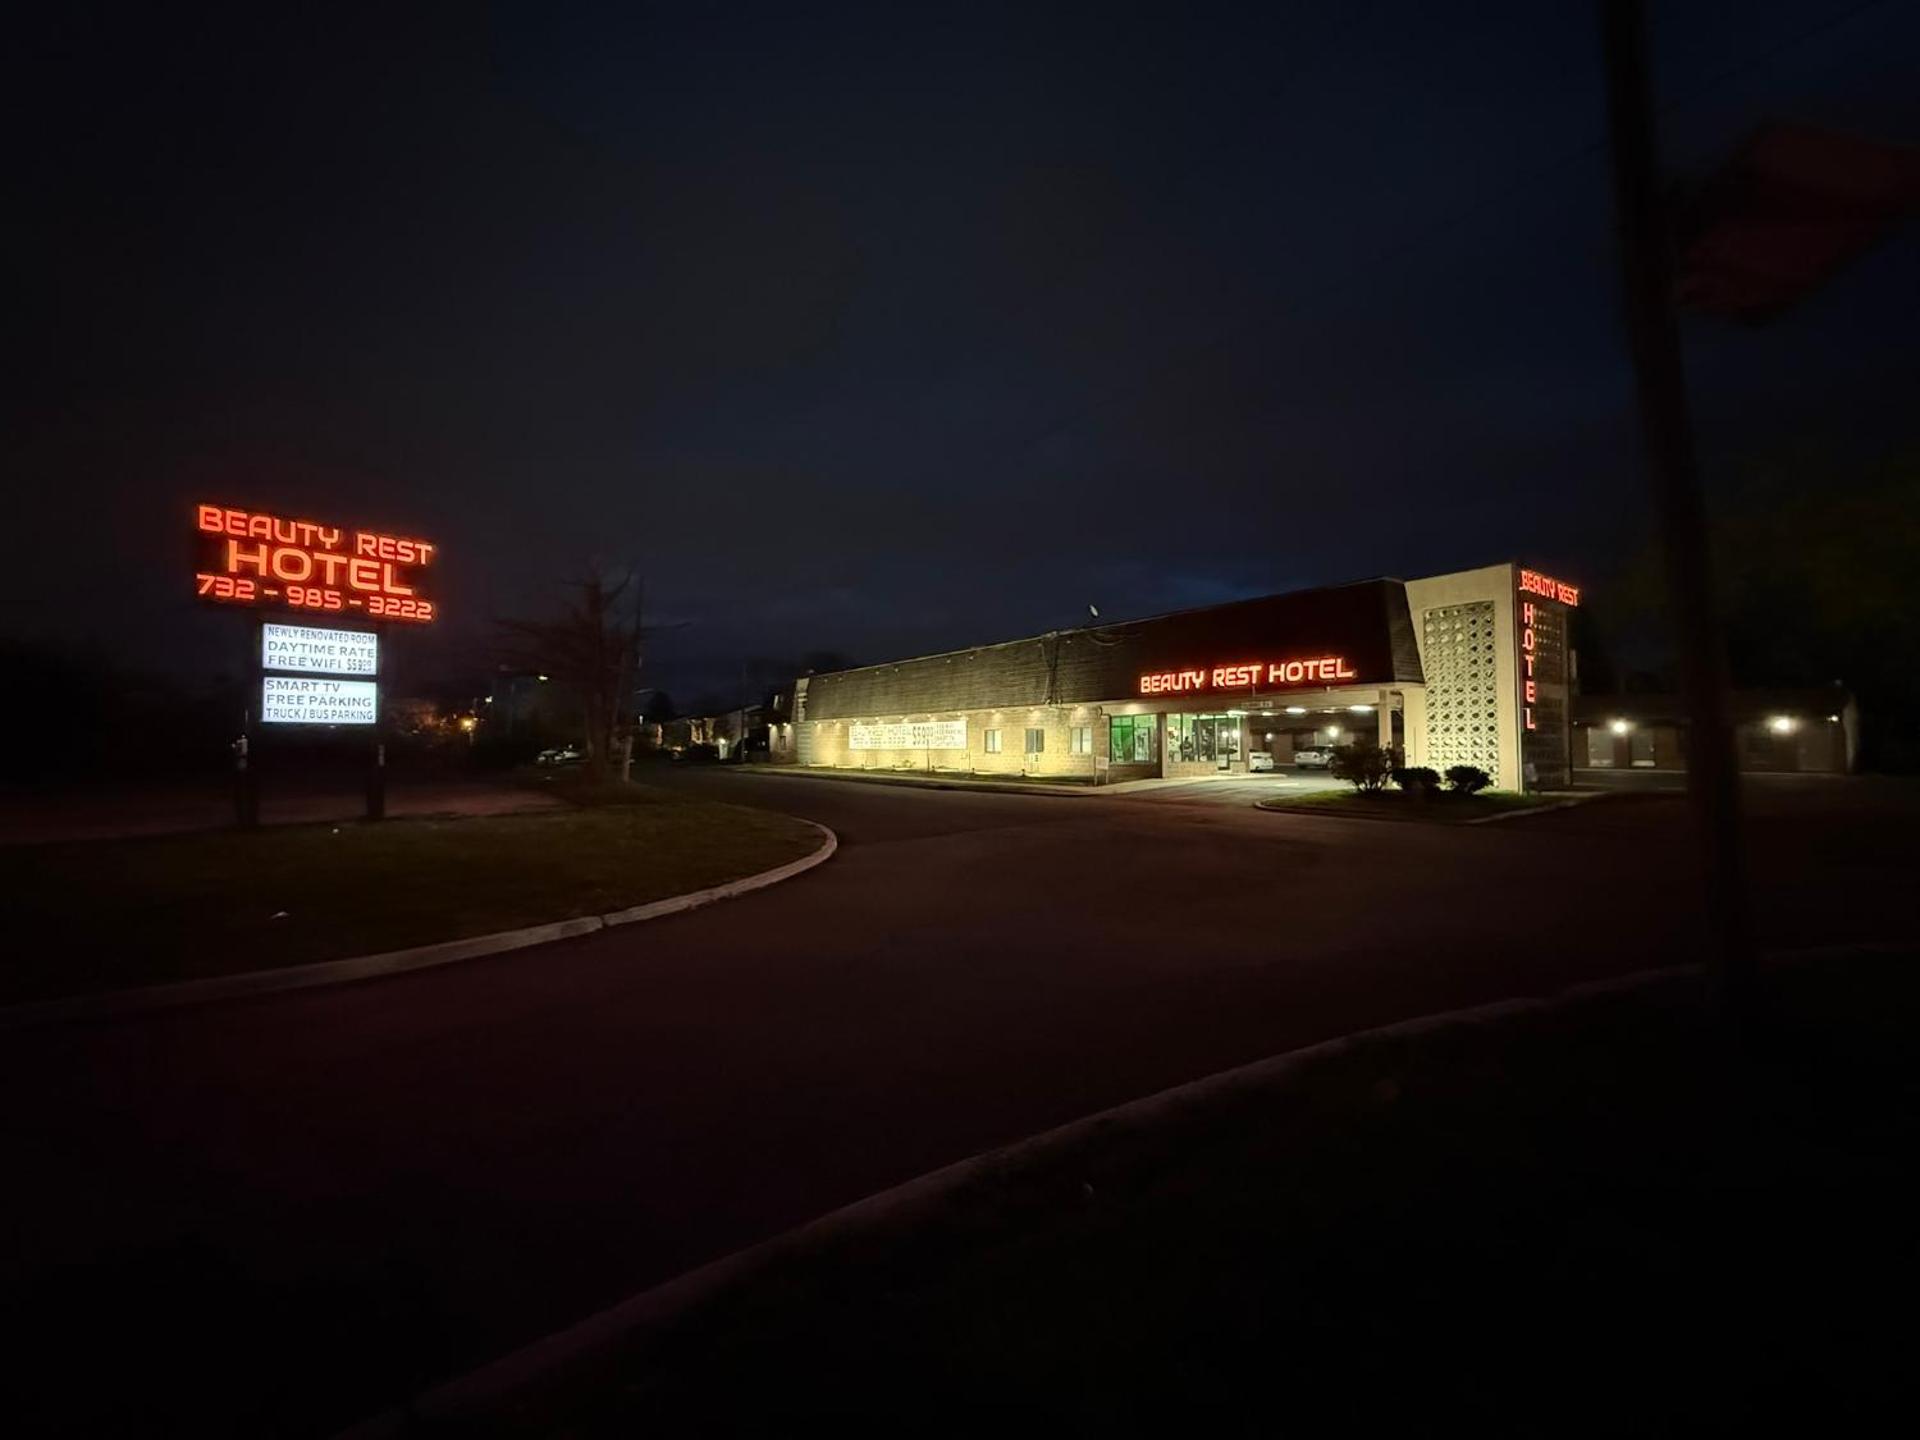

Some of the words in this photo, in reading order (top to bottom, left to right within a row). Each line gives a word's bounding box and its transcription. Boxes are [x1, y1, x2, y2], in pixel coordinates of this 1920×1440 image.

[198, 506, 340, 549] BEAUTY
[357, 533, 433, 565] REST
[228, 540, 413, 596] HOTEL
[197, 574, 255, 600] 732
[287, 586, 342, 609] 985
[369, 596, 432, 620] 3222
[1519, 570, 1555, 599] BEAUTY
[1559, 584, 1578, 606] REST
[268, 627, 299, 639] NEWLY
[301, 629, 349, 643] RENOVATED
[351, 634, 375, 645] ROOM
[268, 641, 335, 655] DAYTIME
[339, 646, 375, 658] RATE
[268, 655, 307, 667] FREE
[311, 658, 341, 669] WIFI
[1140, 670, 1204, 693] BEAUTY
[1212, 665, 1262, 687] REST
[1268, 658, 1354, 682] HOTEL
[1523, 602, 1537, 730] HOTEL
[266, 680, 320, 692] SMART
[324, 683, 341, 693] TV
[267, 694, 304, 705] FREE
[309, 695, 372, 707] PARKING
[266, 708, 300, 719] TRUCK
[310, 709, 329, 720] BUS
[332, 710, 373, 720] PARKING
